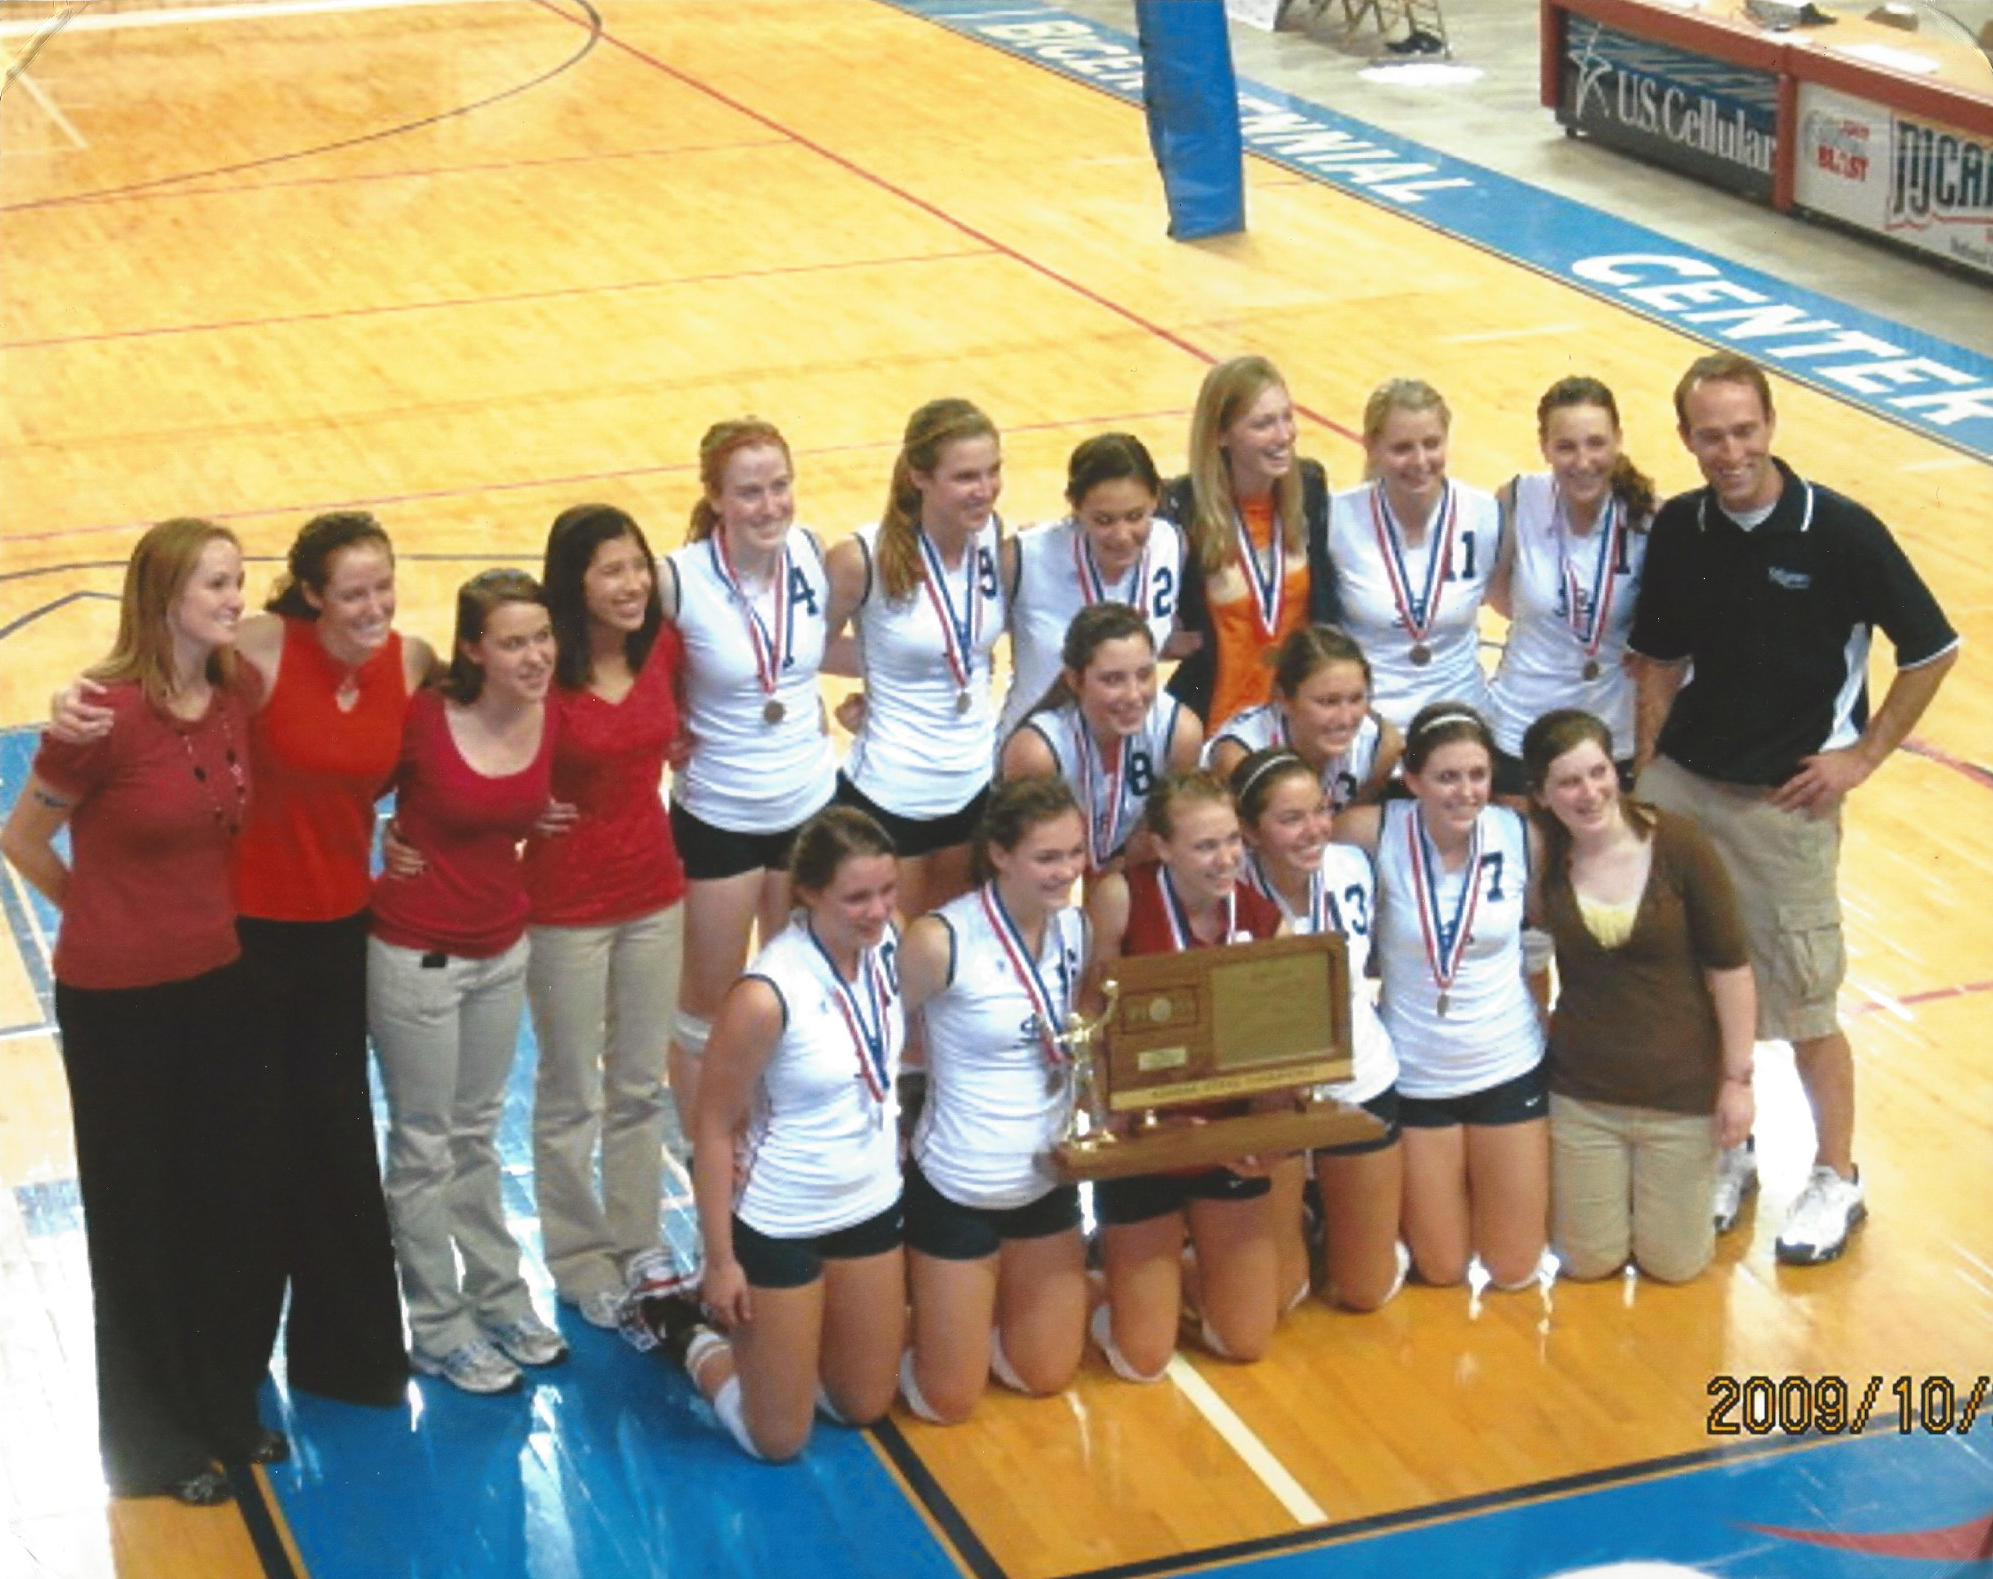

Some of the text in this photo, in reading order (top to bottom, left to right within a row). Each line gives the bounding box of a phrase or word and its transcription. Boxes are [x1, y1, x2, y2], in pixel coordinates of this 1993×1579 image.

[1661, 85, 1776, 172] Cellular
[1893, 120, 1993, 217] NJCA
[1153, 566, 1173, 618] 2
[1127, 751, 1152, 797] 8
[1480, 851, 1506, 902] 7
